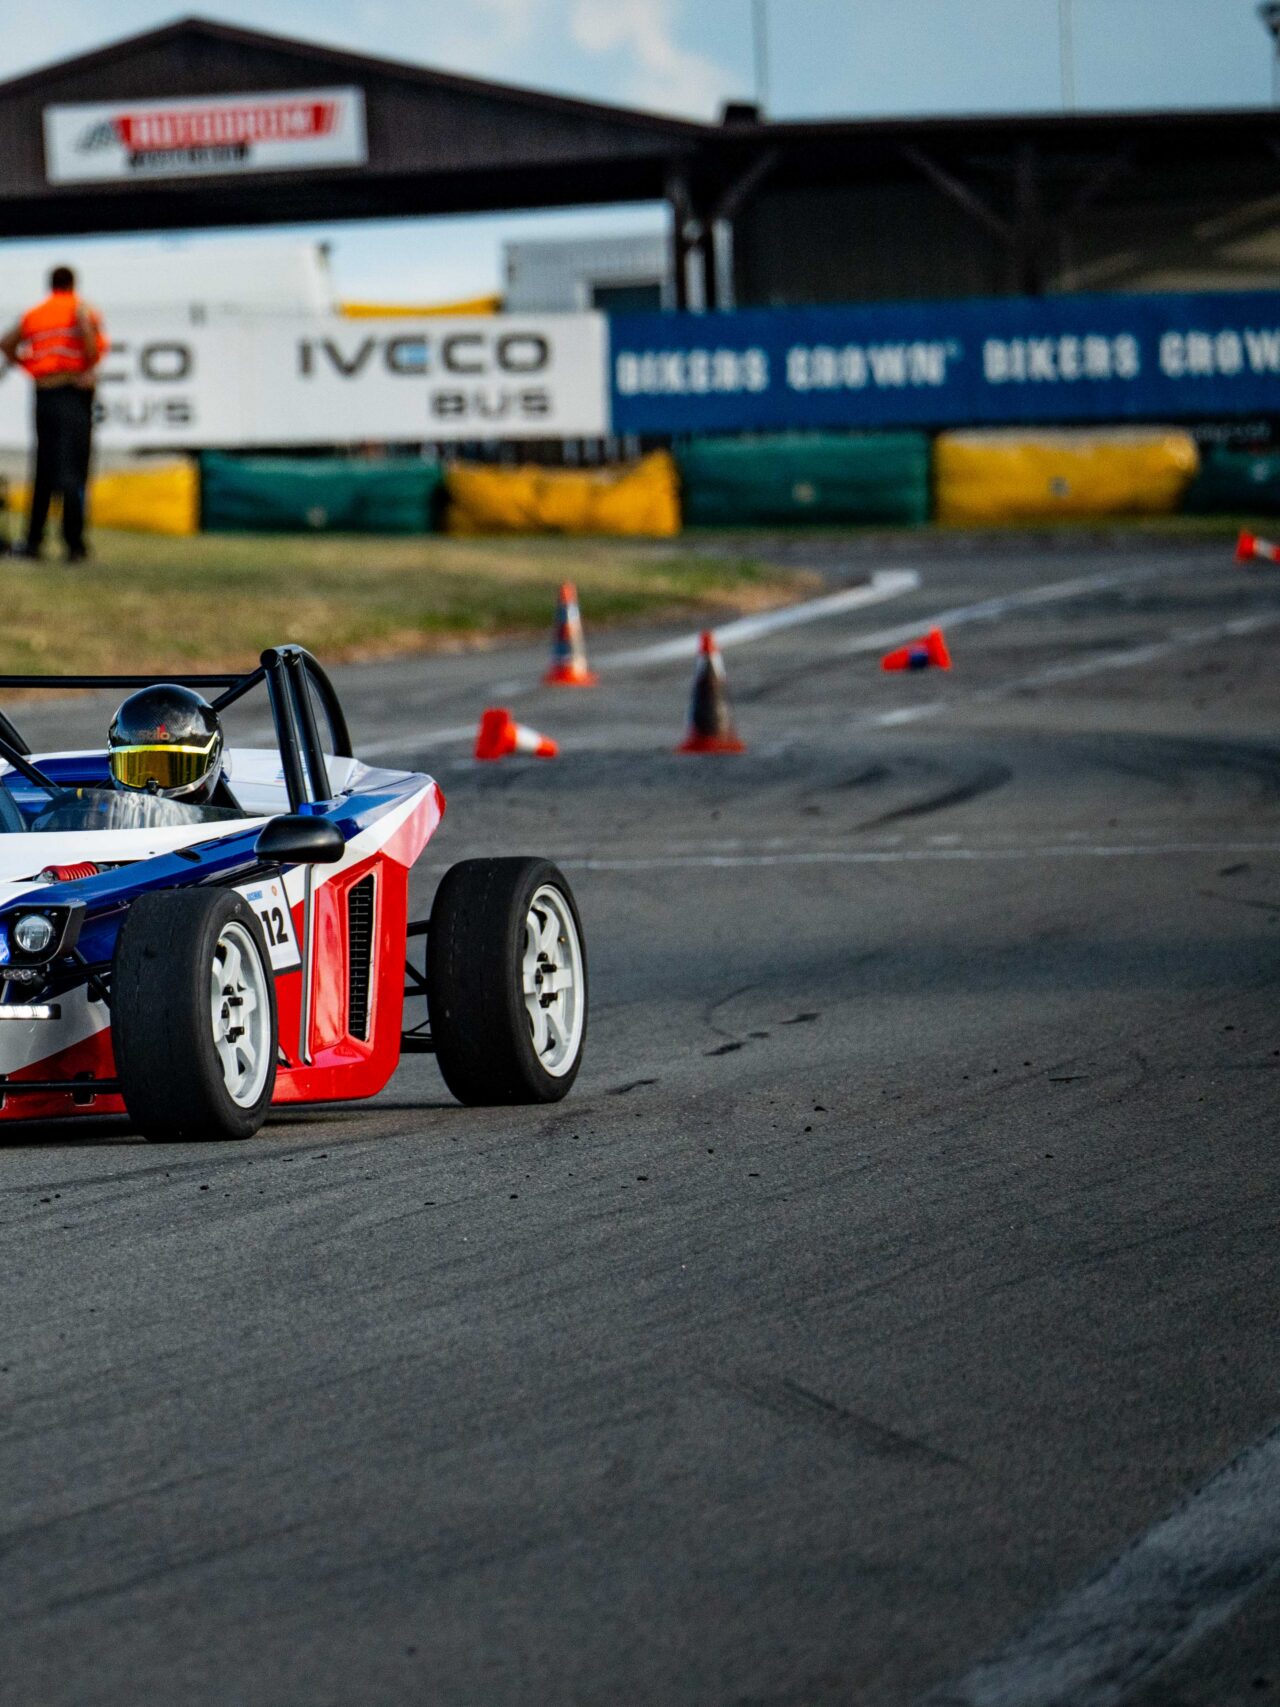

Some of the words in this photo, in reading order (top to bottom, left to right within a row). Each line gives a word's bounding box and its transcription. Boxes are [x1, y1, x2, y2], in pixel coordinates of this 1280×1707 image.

[298, 333, 551, 379] IVECO
[617, 347, 768, 395] BIKERS
[982, 332, 1140, 383] BIKERS
[431, 390, 550, 418] BUS
